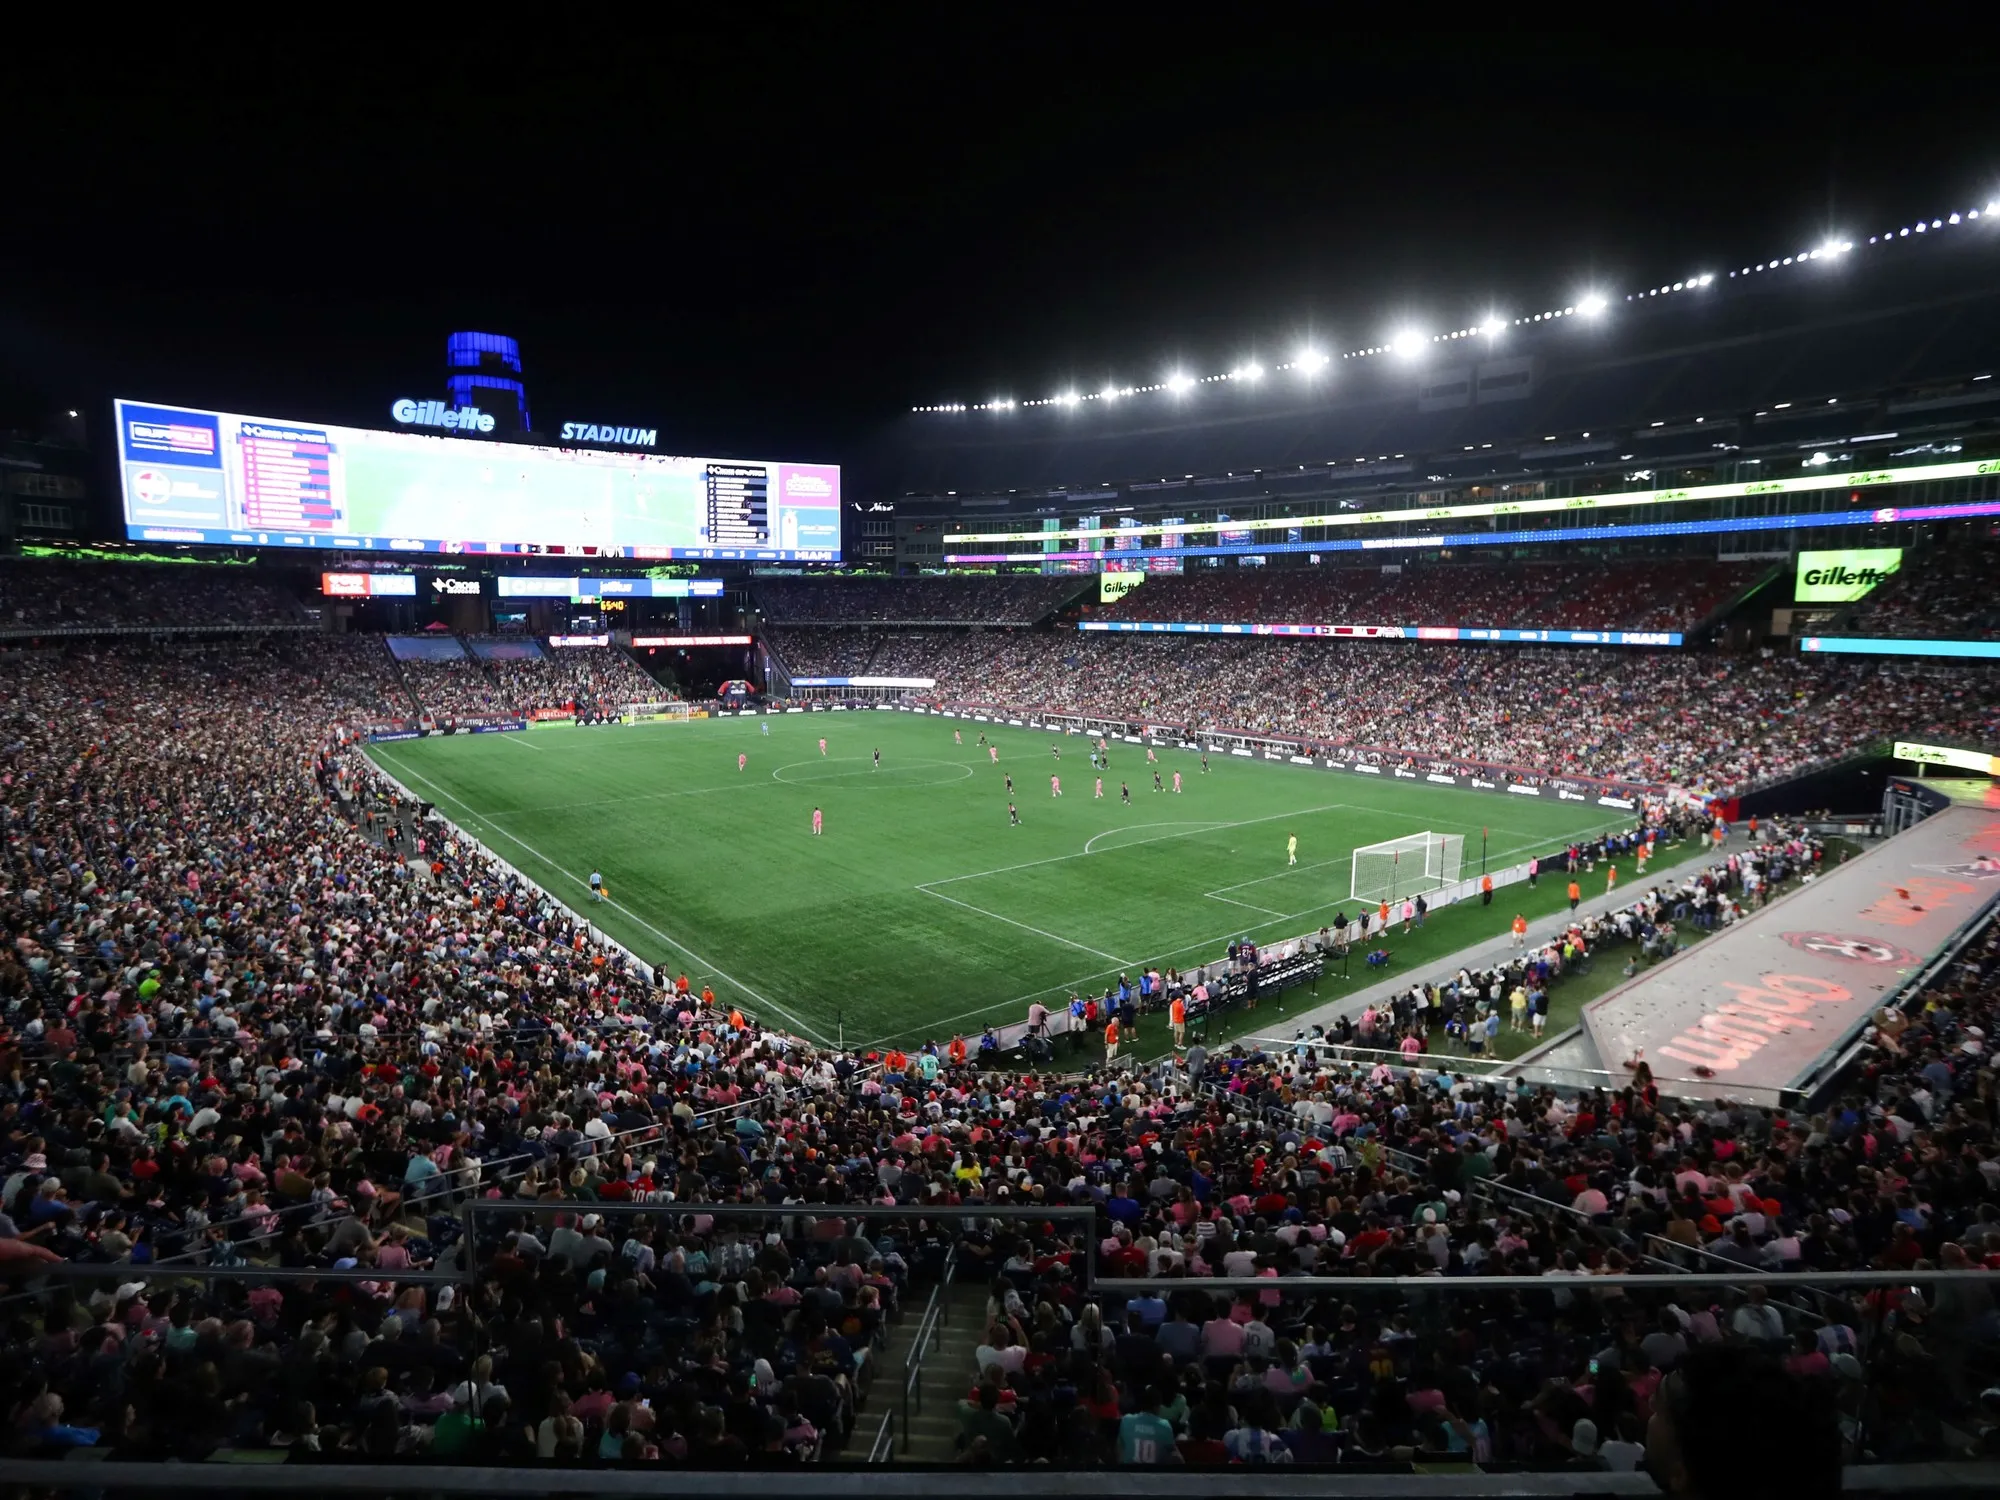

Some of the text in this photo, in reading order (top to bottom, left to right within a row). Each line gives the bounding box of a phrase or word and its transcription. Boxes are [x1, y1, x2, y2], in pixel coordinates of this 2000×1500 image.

[391, 399, 496, 433] Gillette
[561, 422, 657, 446] STADIUM
[794, 551, 832, 561] MIAMI
[1803, 566, 1888, 586] Gillette
[1104, 581, 1135, 593] Gillett
[1621, 632, 1670, 645] MIAMI
[1657, 974, 1852, 1071] Optum
[632, 1189, 646, 1202] 10
[1246, 1332, 1260, 1347] 10
[1133, 1437, 1157, 1464] 10
